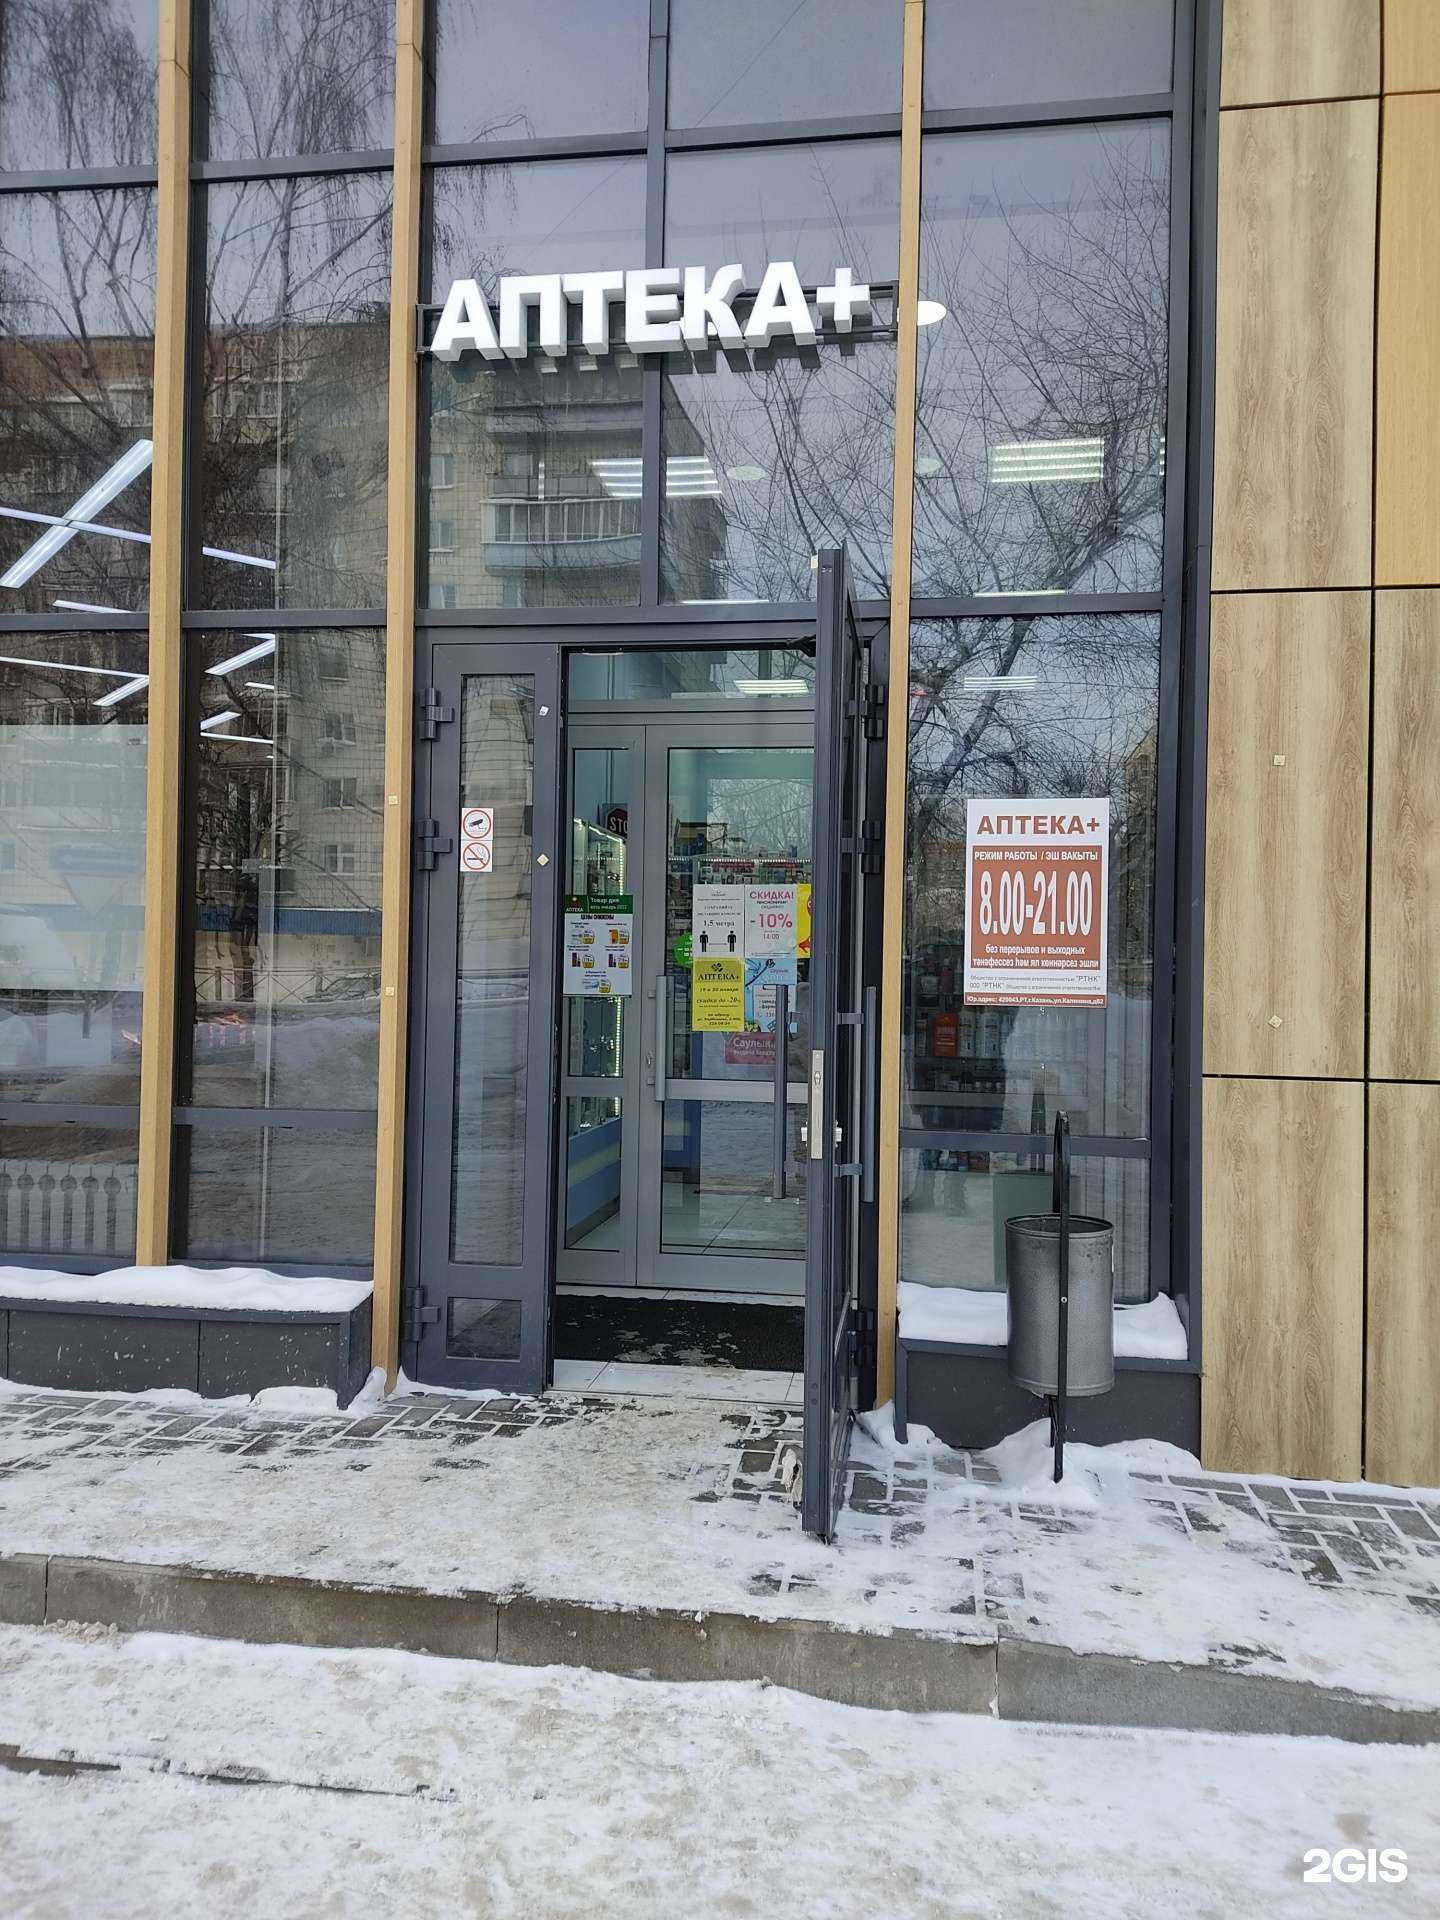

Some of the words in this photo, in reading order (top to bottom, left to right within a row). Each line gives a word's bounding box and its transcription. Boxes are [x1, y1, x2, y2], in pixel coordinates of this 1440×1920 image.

[430, 261, 870, 361] АПТЕКА+
[977, 815, 1099, 835] АПТЕКА+
[975, 851, 1003, 861] РЕЖИМ
[1004, 851, 1038, 861] РАБОТЫ
[1061, 851, 1098, 861] ВАКЫТЫ
[750, 890, 794, 900] СКИДКА!
[979, 870, 1093, 936] 8.00-21.00
[985, 944, 999, 954] без
[999, 945, 1039, 956] перерывов
[1047, 946, 1086, 956] выходных
